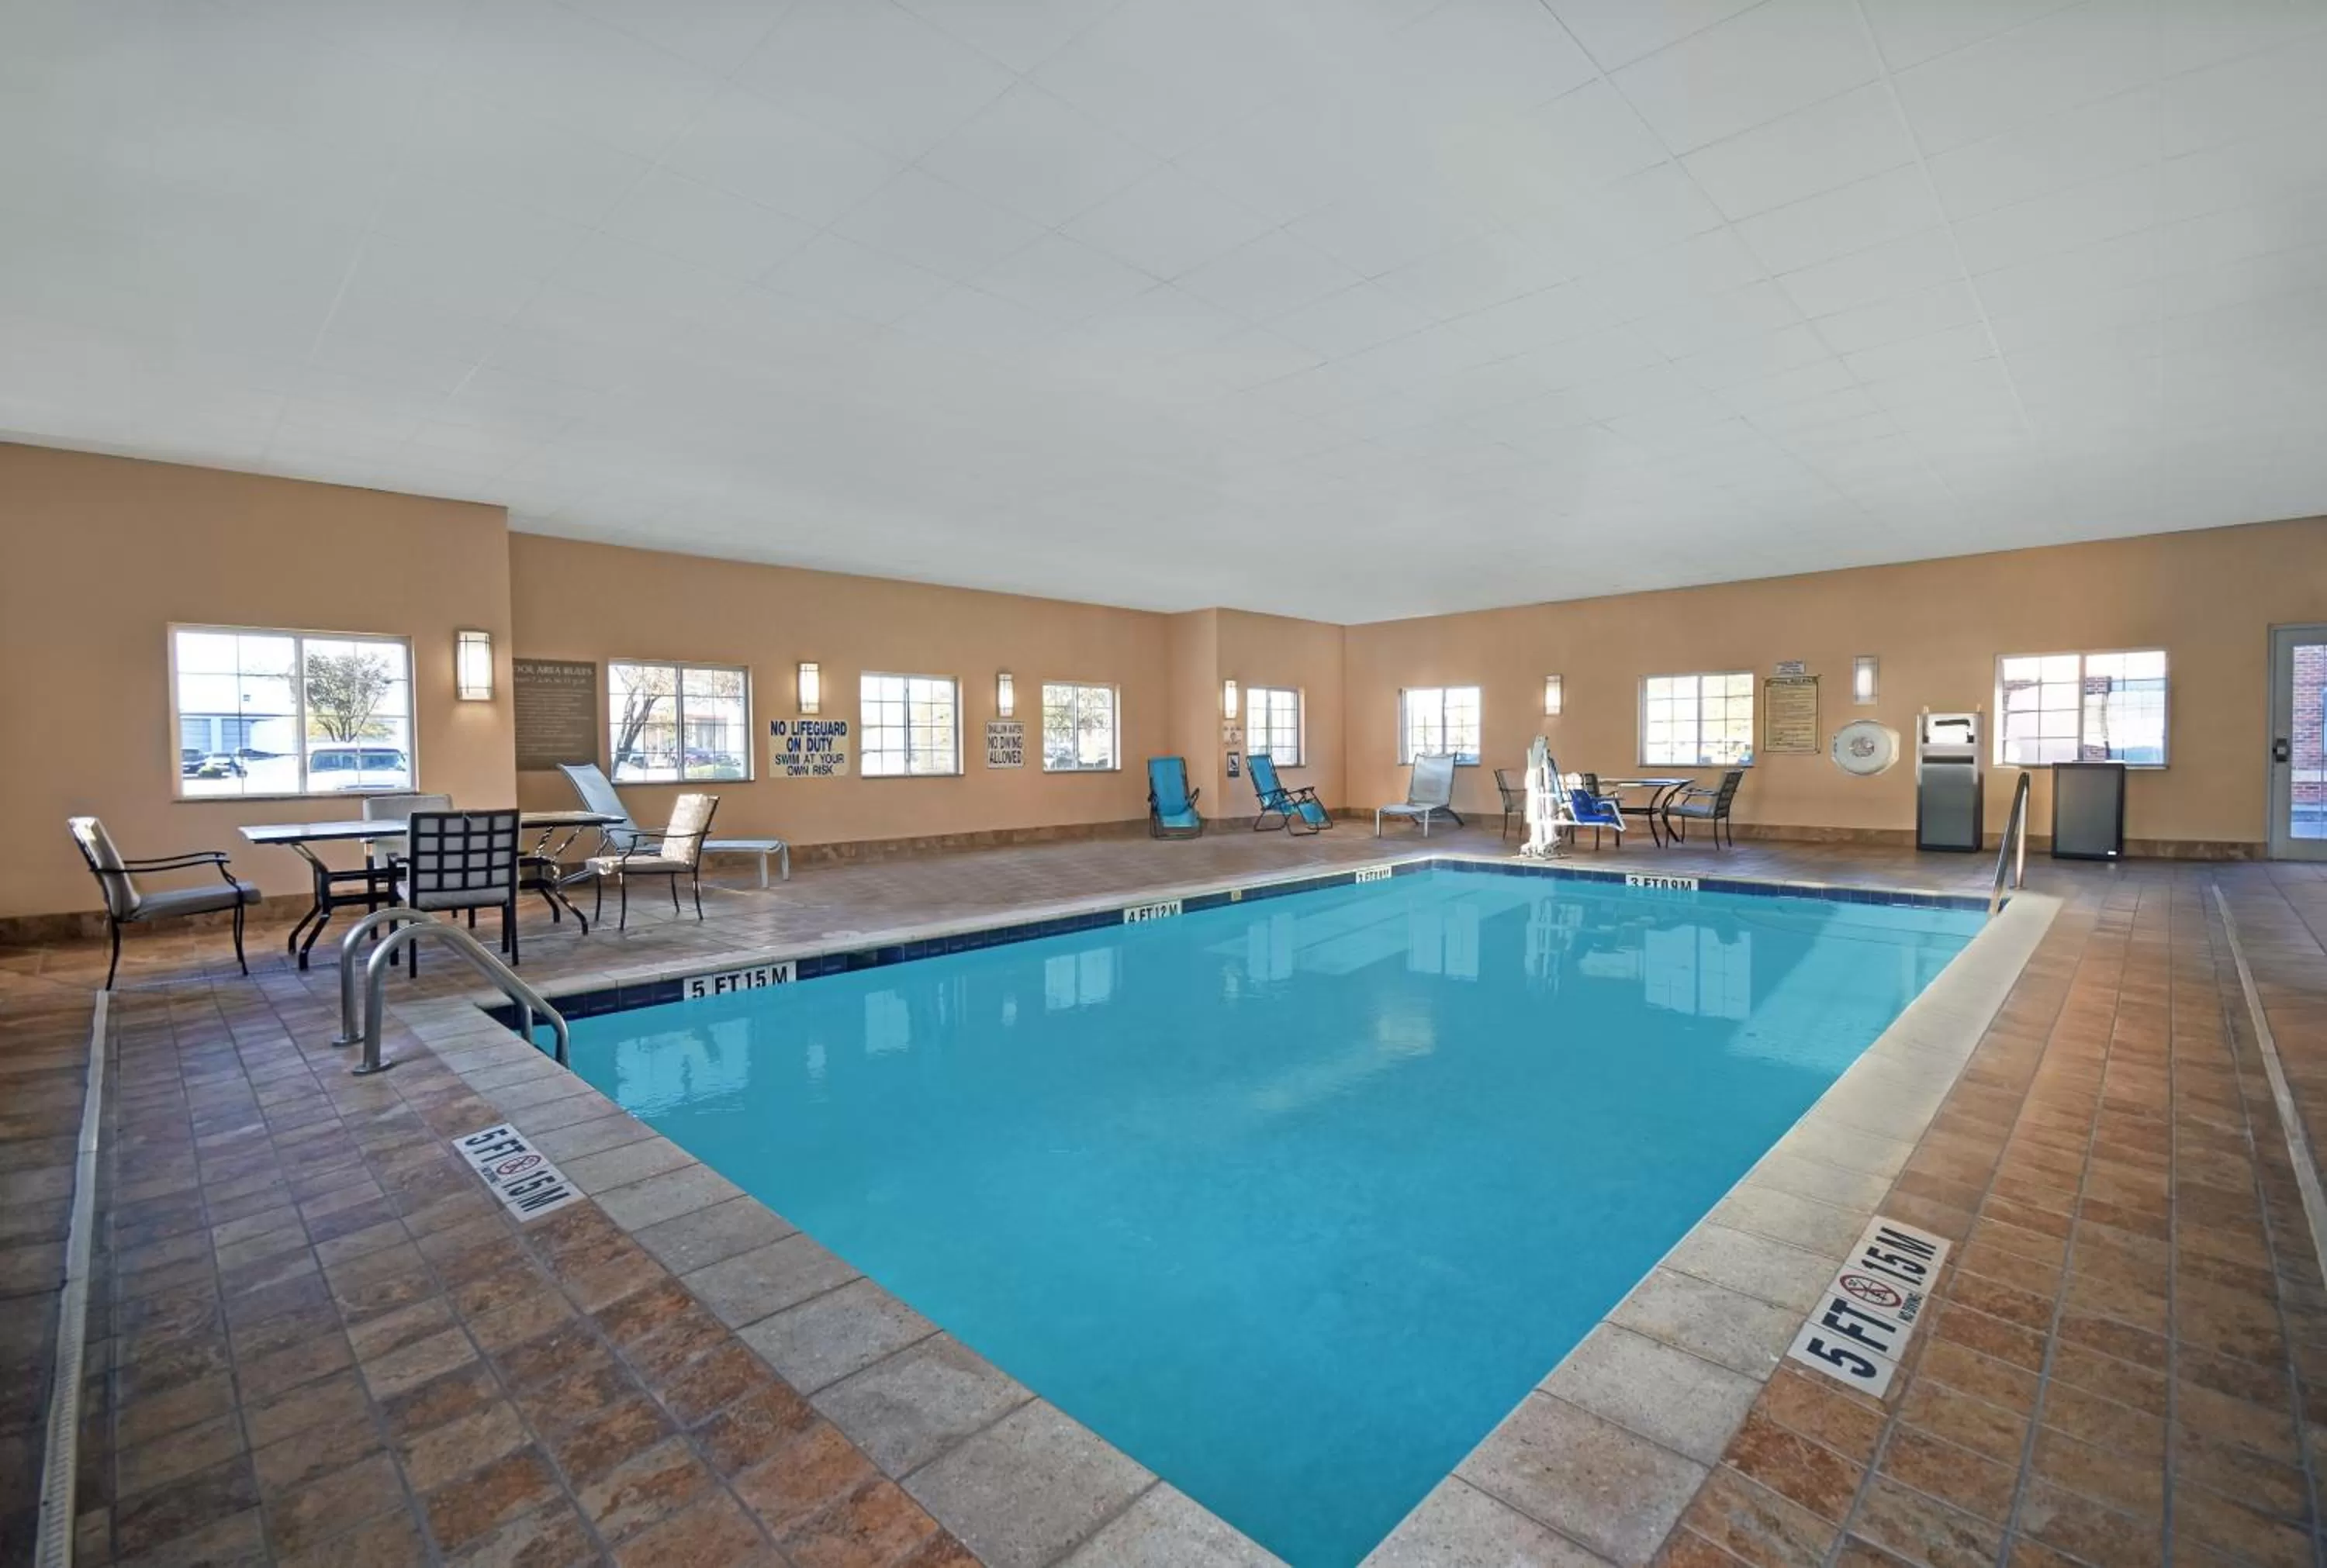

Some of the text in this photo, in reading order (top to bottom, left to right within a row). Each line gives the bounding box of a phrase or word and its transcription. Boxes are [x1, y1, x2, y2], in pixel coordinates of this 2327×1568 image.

[771, 720, 847, 736] NO LIFEGUARD
[787, 737, 833, 752] ON DUTY
[987, 736, 998, 749] NO
[776, 753, 844, 765] SWIM AT YOUR
[989, 750, 1022, 764] ALLOWED
[787, 765, 833, 776] OWN RISK
[1644, 877, 1659, 889] FT
[1129, 911, 1136, 923] 4
[692, 980, 705, 999] 5
[714, 974, 739, 996] FT
[465, 1128, 510, 1146] 5
[474, 1138, 527, 1163] FT
[1821, 1297, 1897, 1353] FT
[1806, 1337, 1877, 1379] 5
